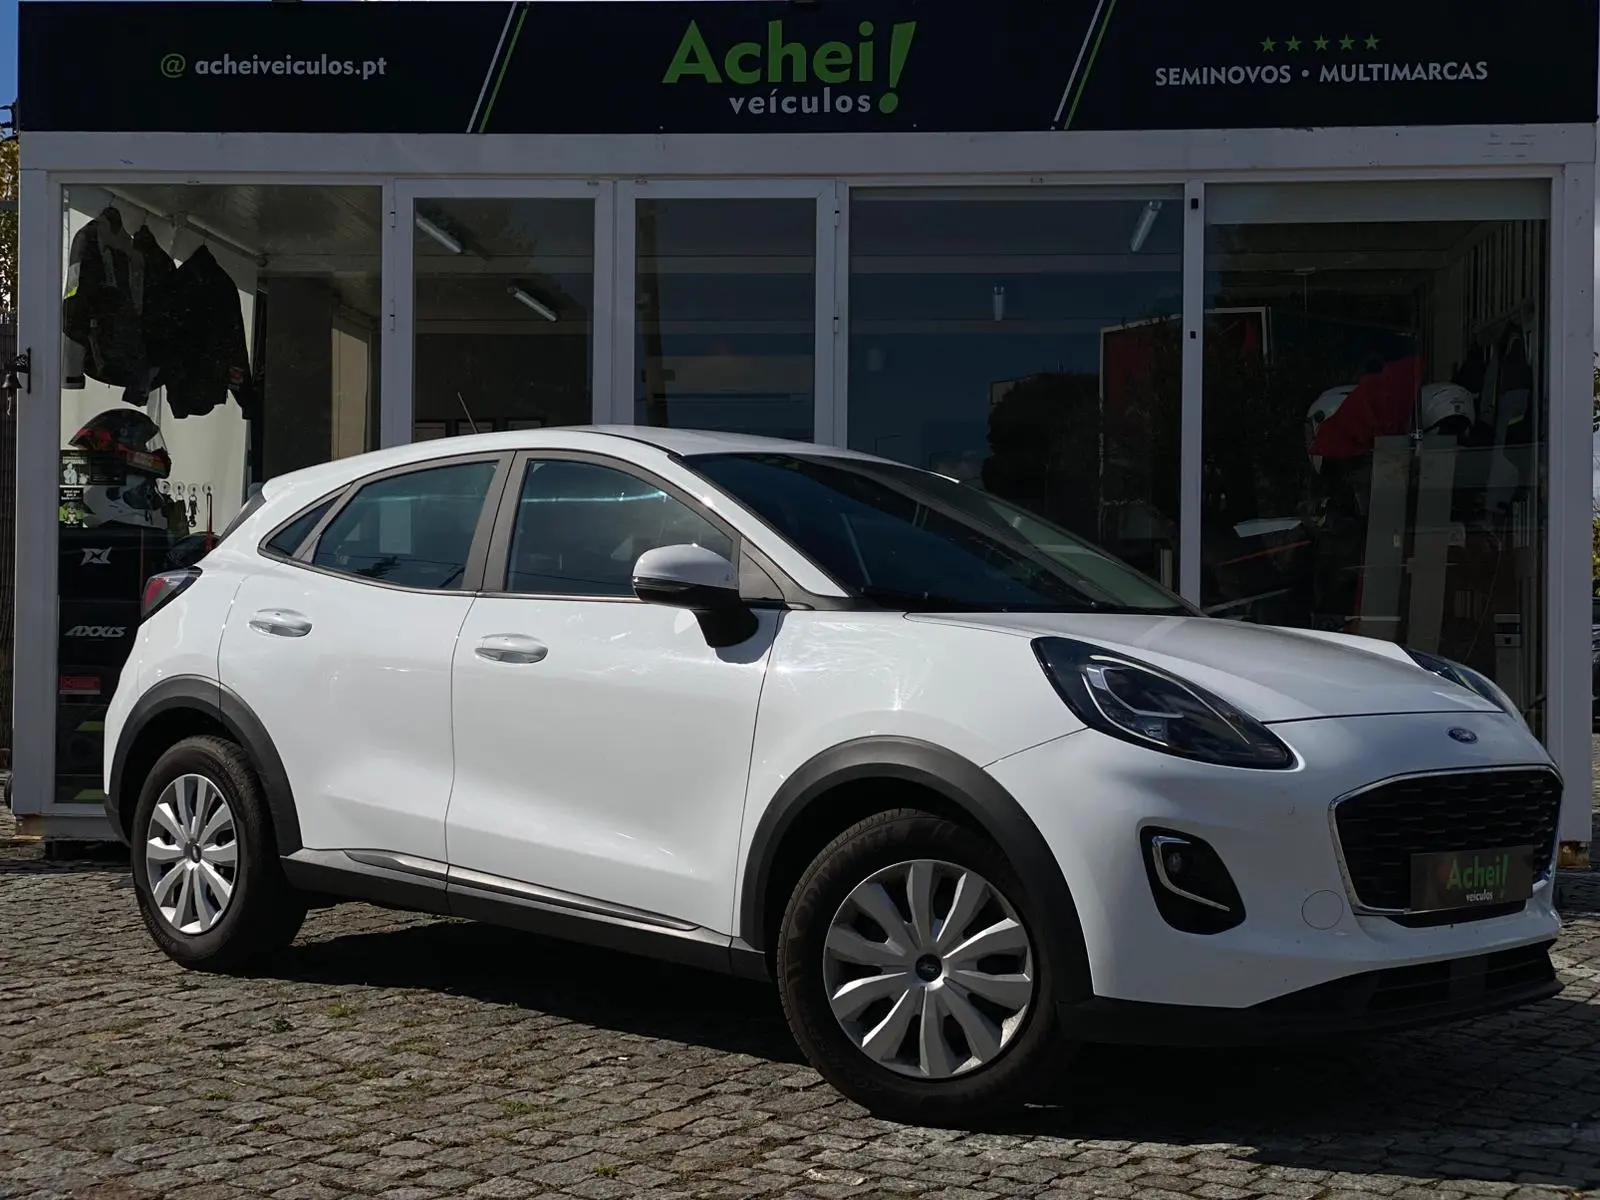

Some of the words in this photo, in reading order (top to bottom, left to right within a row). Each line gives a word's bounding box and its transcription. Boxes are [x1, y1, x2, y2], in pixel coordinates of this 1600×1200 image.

[195, 53, 387, 80] acheiveiculos.pt
[661, 19, 917, 114] Achei!
[1155, 64, 1291, 86] SEMINOVOS
[1319, 61, 1488, 83] MULTIMARCAS
[729, 86, 871, 115] veículos
[1446, 853, 1509, 899] Achei!
